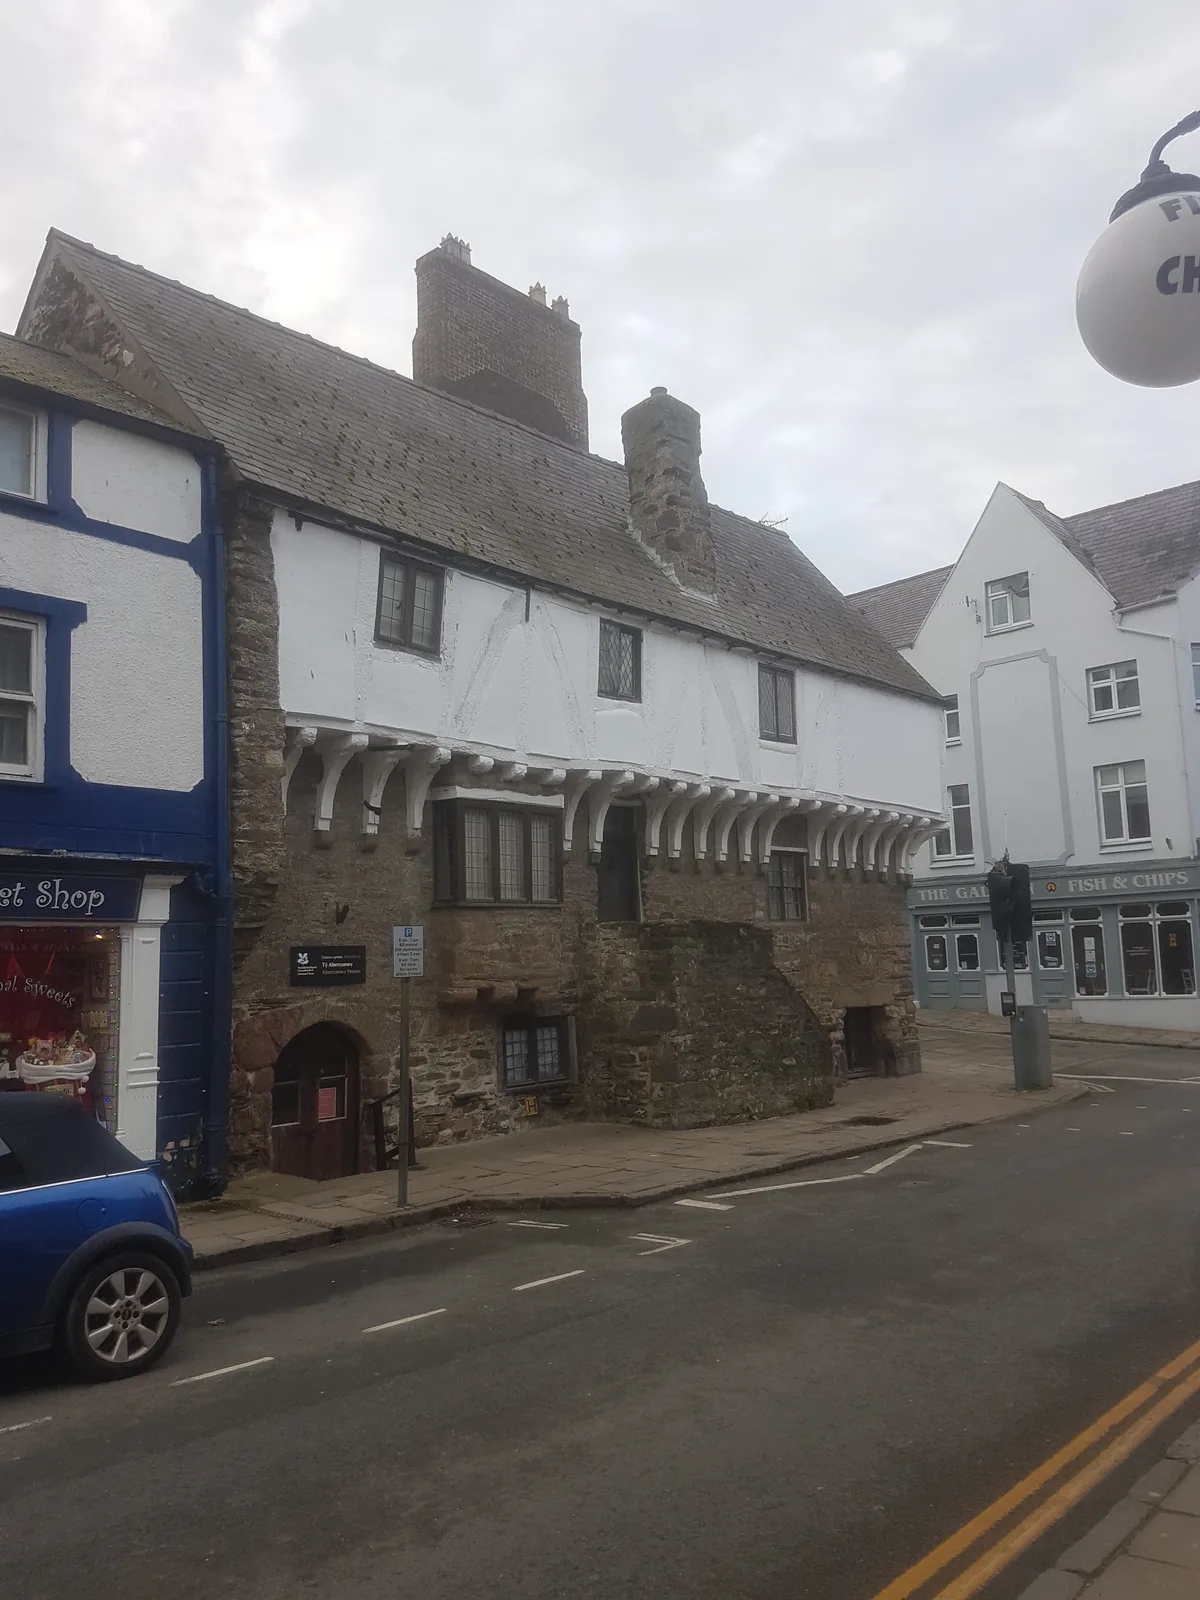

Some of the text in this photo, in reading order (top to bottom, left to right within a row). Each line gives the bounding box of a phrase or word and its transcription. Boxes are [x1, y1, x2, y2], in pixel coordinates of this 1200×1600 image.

[1068, 872, 1189, 893] FISH & CHIPS
[0, 879, 105, 915] et Shop
[918, 888, 949, 901] THE
[406, 928, 412, 937] P
[24, 977, 76, 1008] Sweets
